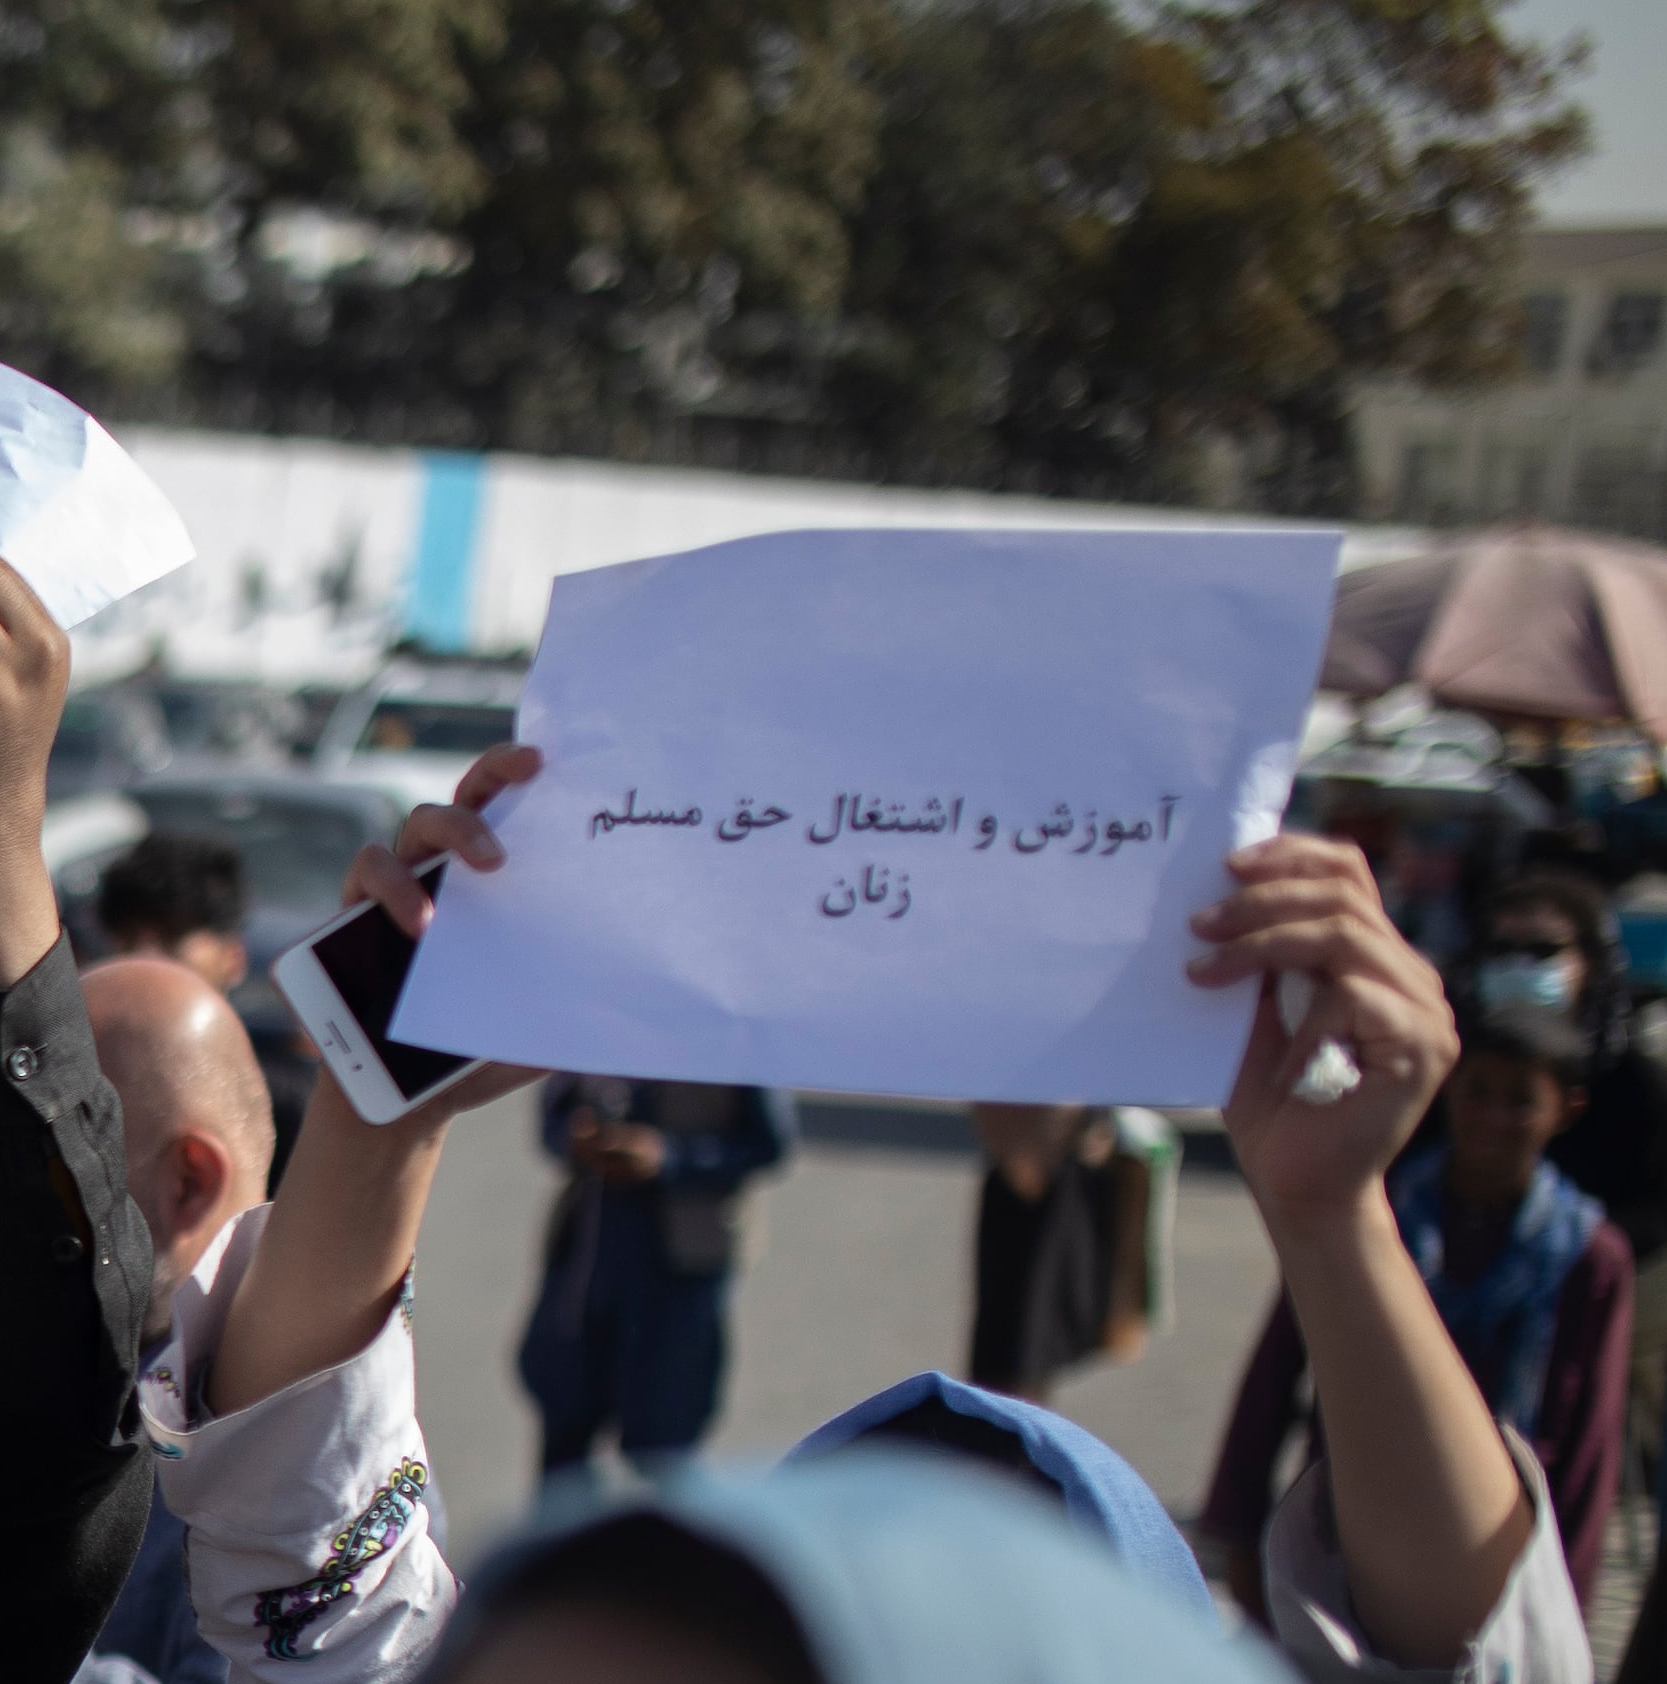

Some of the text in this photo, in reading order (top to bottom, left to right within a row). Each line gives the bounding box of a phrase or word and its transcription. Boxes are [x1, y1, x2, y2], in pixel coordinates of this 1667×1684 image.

[589, 787, 1182, 857] آموزش و اشتغال حق مسلم
[819, 863, 912, 920] زنان
